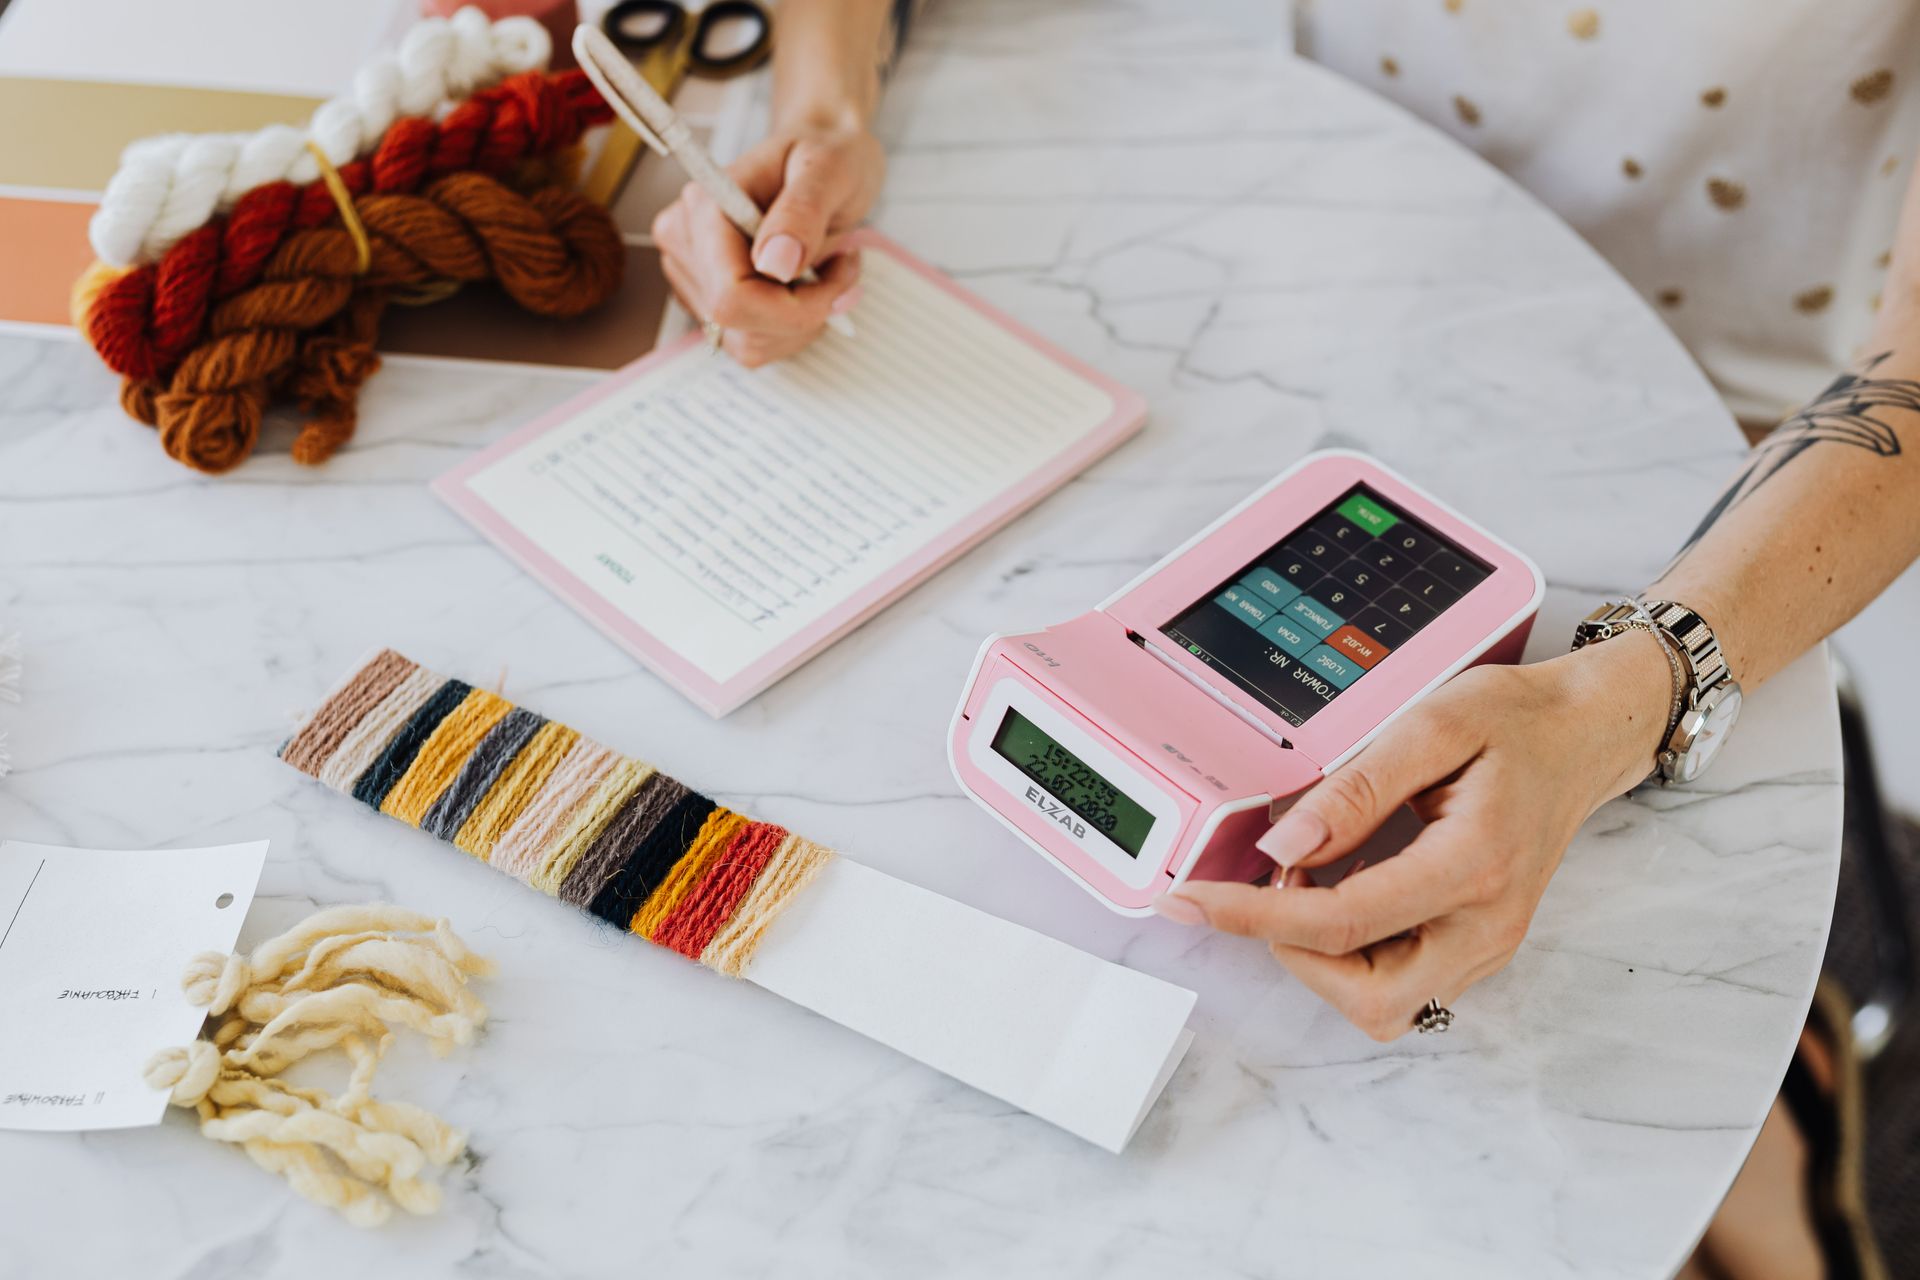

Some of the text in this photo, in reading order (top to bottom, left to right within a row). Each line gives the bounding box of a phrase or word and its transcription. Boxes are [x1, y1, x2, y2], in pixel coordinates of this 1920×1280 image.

[1337, 527, 1349, 538] 3
[1403, 538, 1416, 548] 0
[1312, 545, 1325, 556] 6
[1379, 555, 1392, 566] 2
[1288, 563, 1301, 575] 9
[1355, 574, 1369, 584] 5
[1260, 579, 1280, 594] KOD
[1425, 584, 1433, 595] 1
[1331, 592, 1344, 603] 8
[1224, 590, 1266, 622] TOWAR NR
[1401, 602, 1411, 614] 4
[1294, 602, 1333, 631] FUNKCJE
[1374, 622, 1386, 632] 7
[1277, 626, 1300, 645] CENA
[1293, 666, 1335, 702] TOWAR
[1043, 744, 1120, 808] 15:22:35
[1024, 754, 1119, 832] 22.07.2020
[1024, 785, 1087, 840] ELZAB
